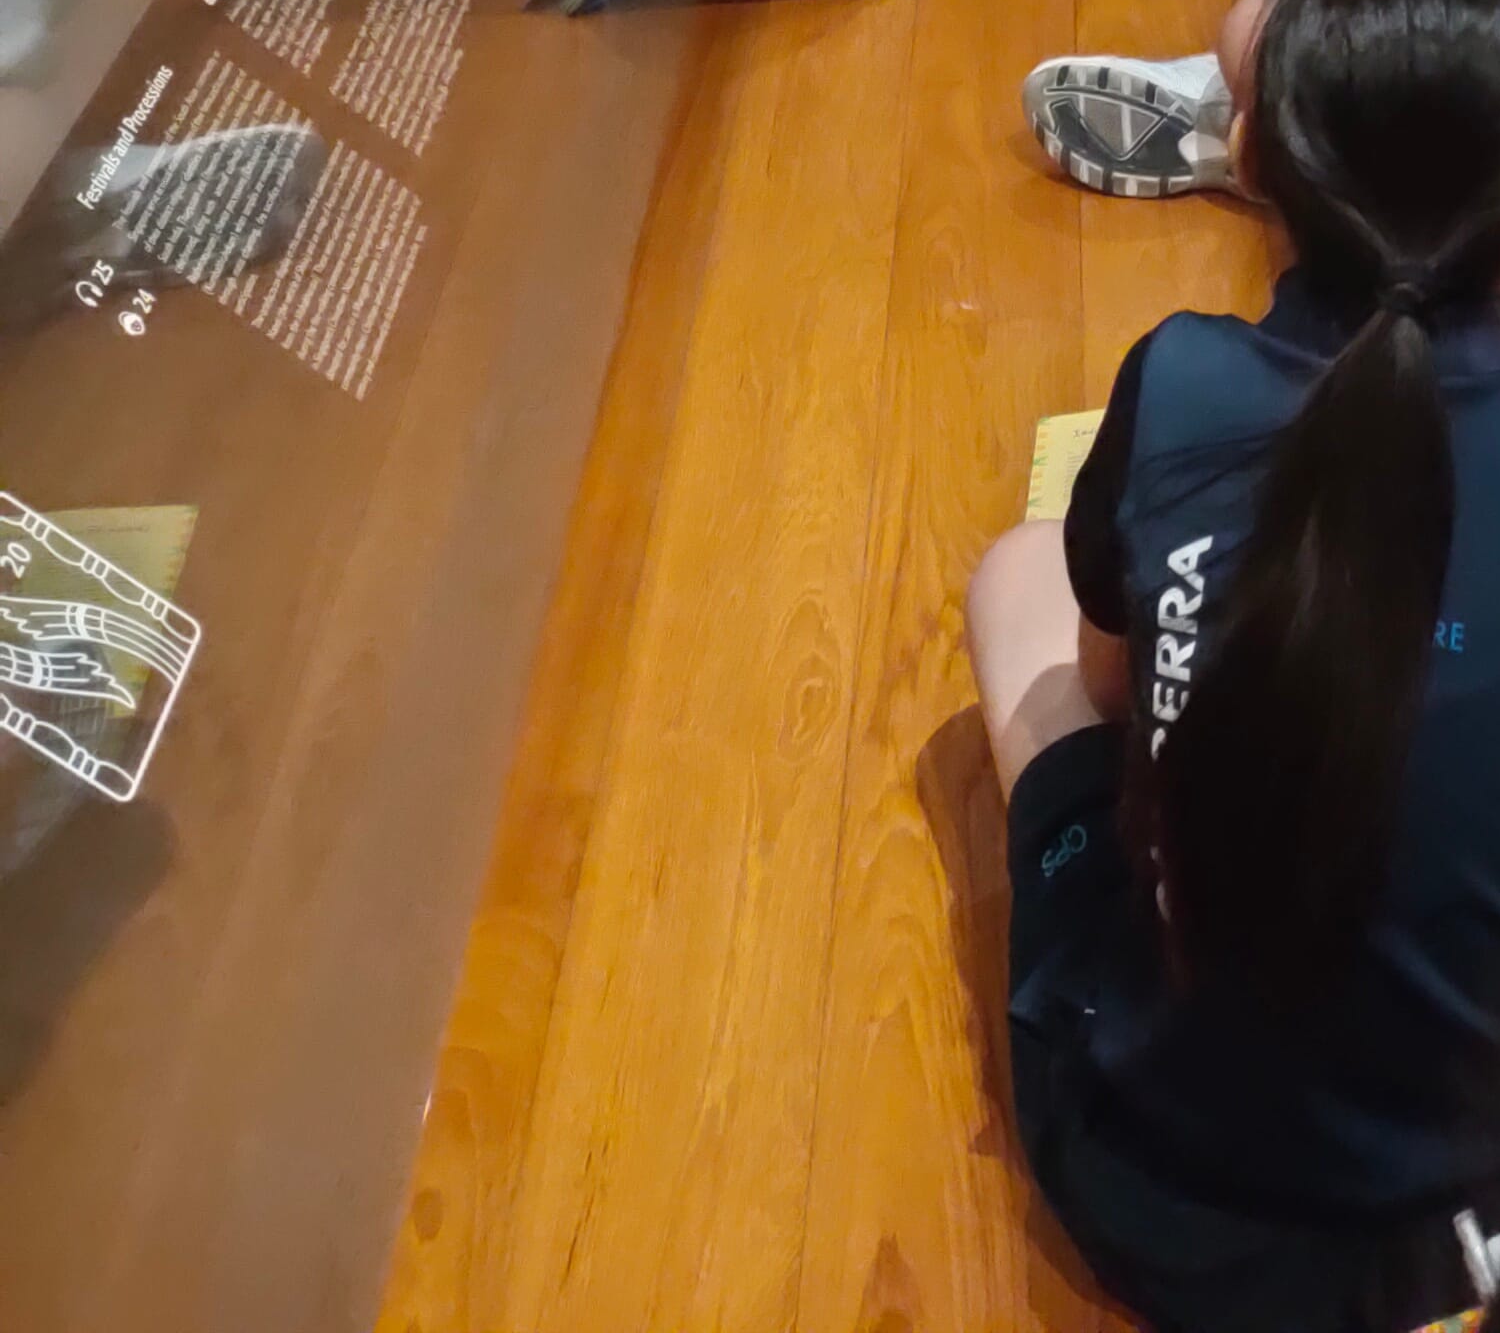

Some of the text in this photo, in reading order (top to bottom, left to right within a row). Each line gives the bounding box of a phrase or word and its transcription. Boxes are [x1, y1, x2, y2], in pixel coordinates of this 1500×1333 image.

[76, 64, 174, 211] Festivals and Processions
[91, 258, 116, 287] 25
[132, 287, 157, 315] 24
[0, 542, 32, 578] 20
[1149, 534, 1214, 759] ERRA
